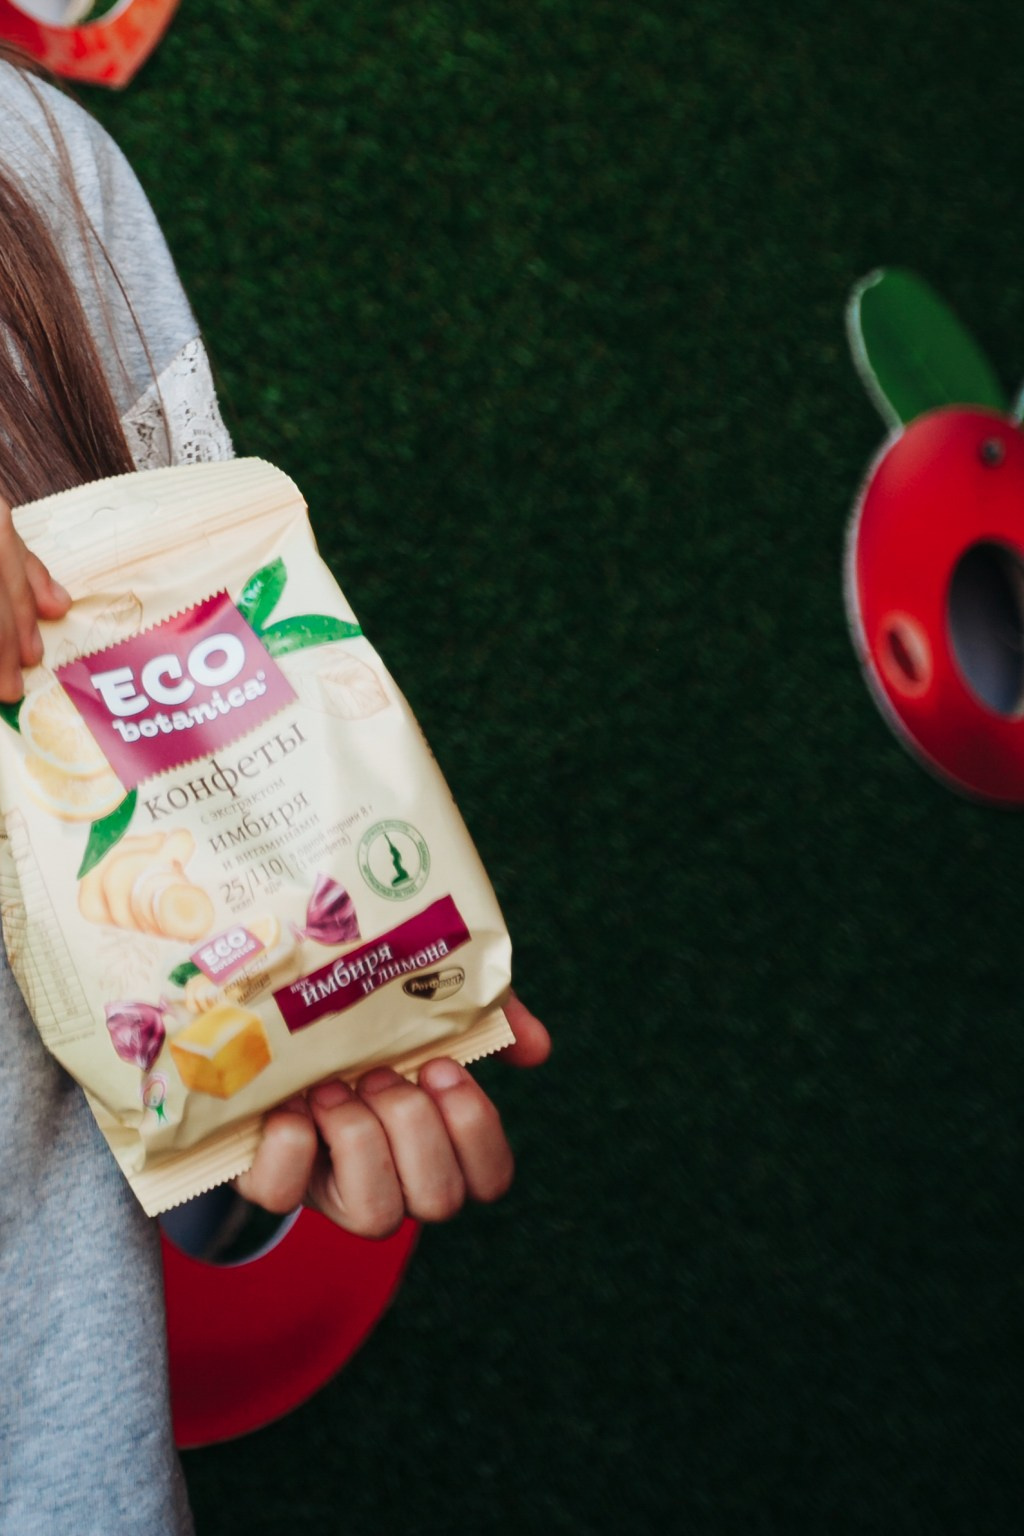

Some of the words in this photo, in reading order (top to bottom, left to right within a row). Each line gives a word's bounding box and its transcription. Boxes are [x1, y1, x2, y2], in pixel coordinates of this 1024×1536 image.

[91, 632, 246, 718] ECO
[112, 678, 268, 744] botanica
[142, 721, 308, 824] конфеты
[208, 791, 312, 856] имбиря
[198, 927, 247, 967] ECO
[301, 941, 394, 1007] имбиря
[362, 979, 375, 995] и
[378, 939, 451, 984] лимона
